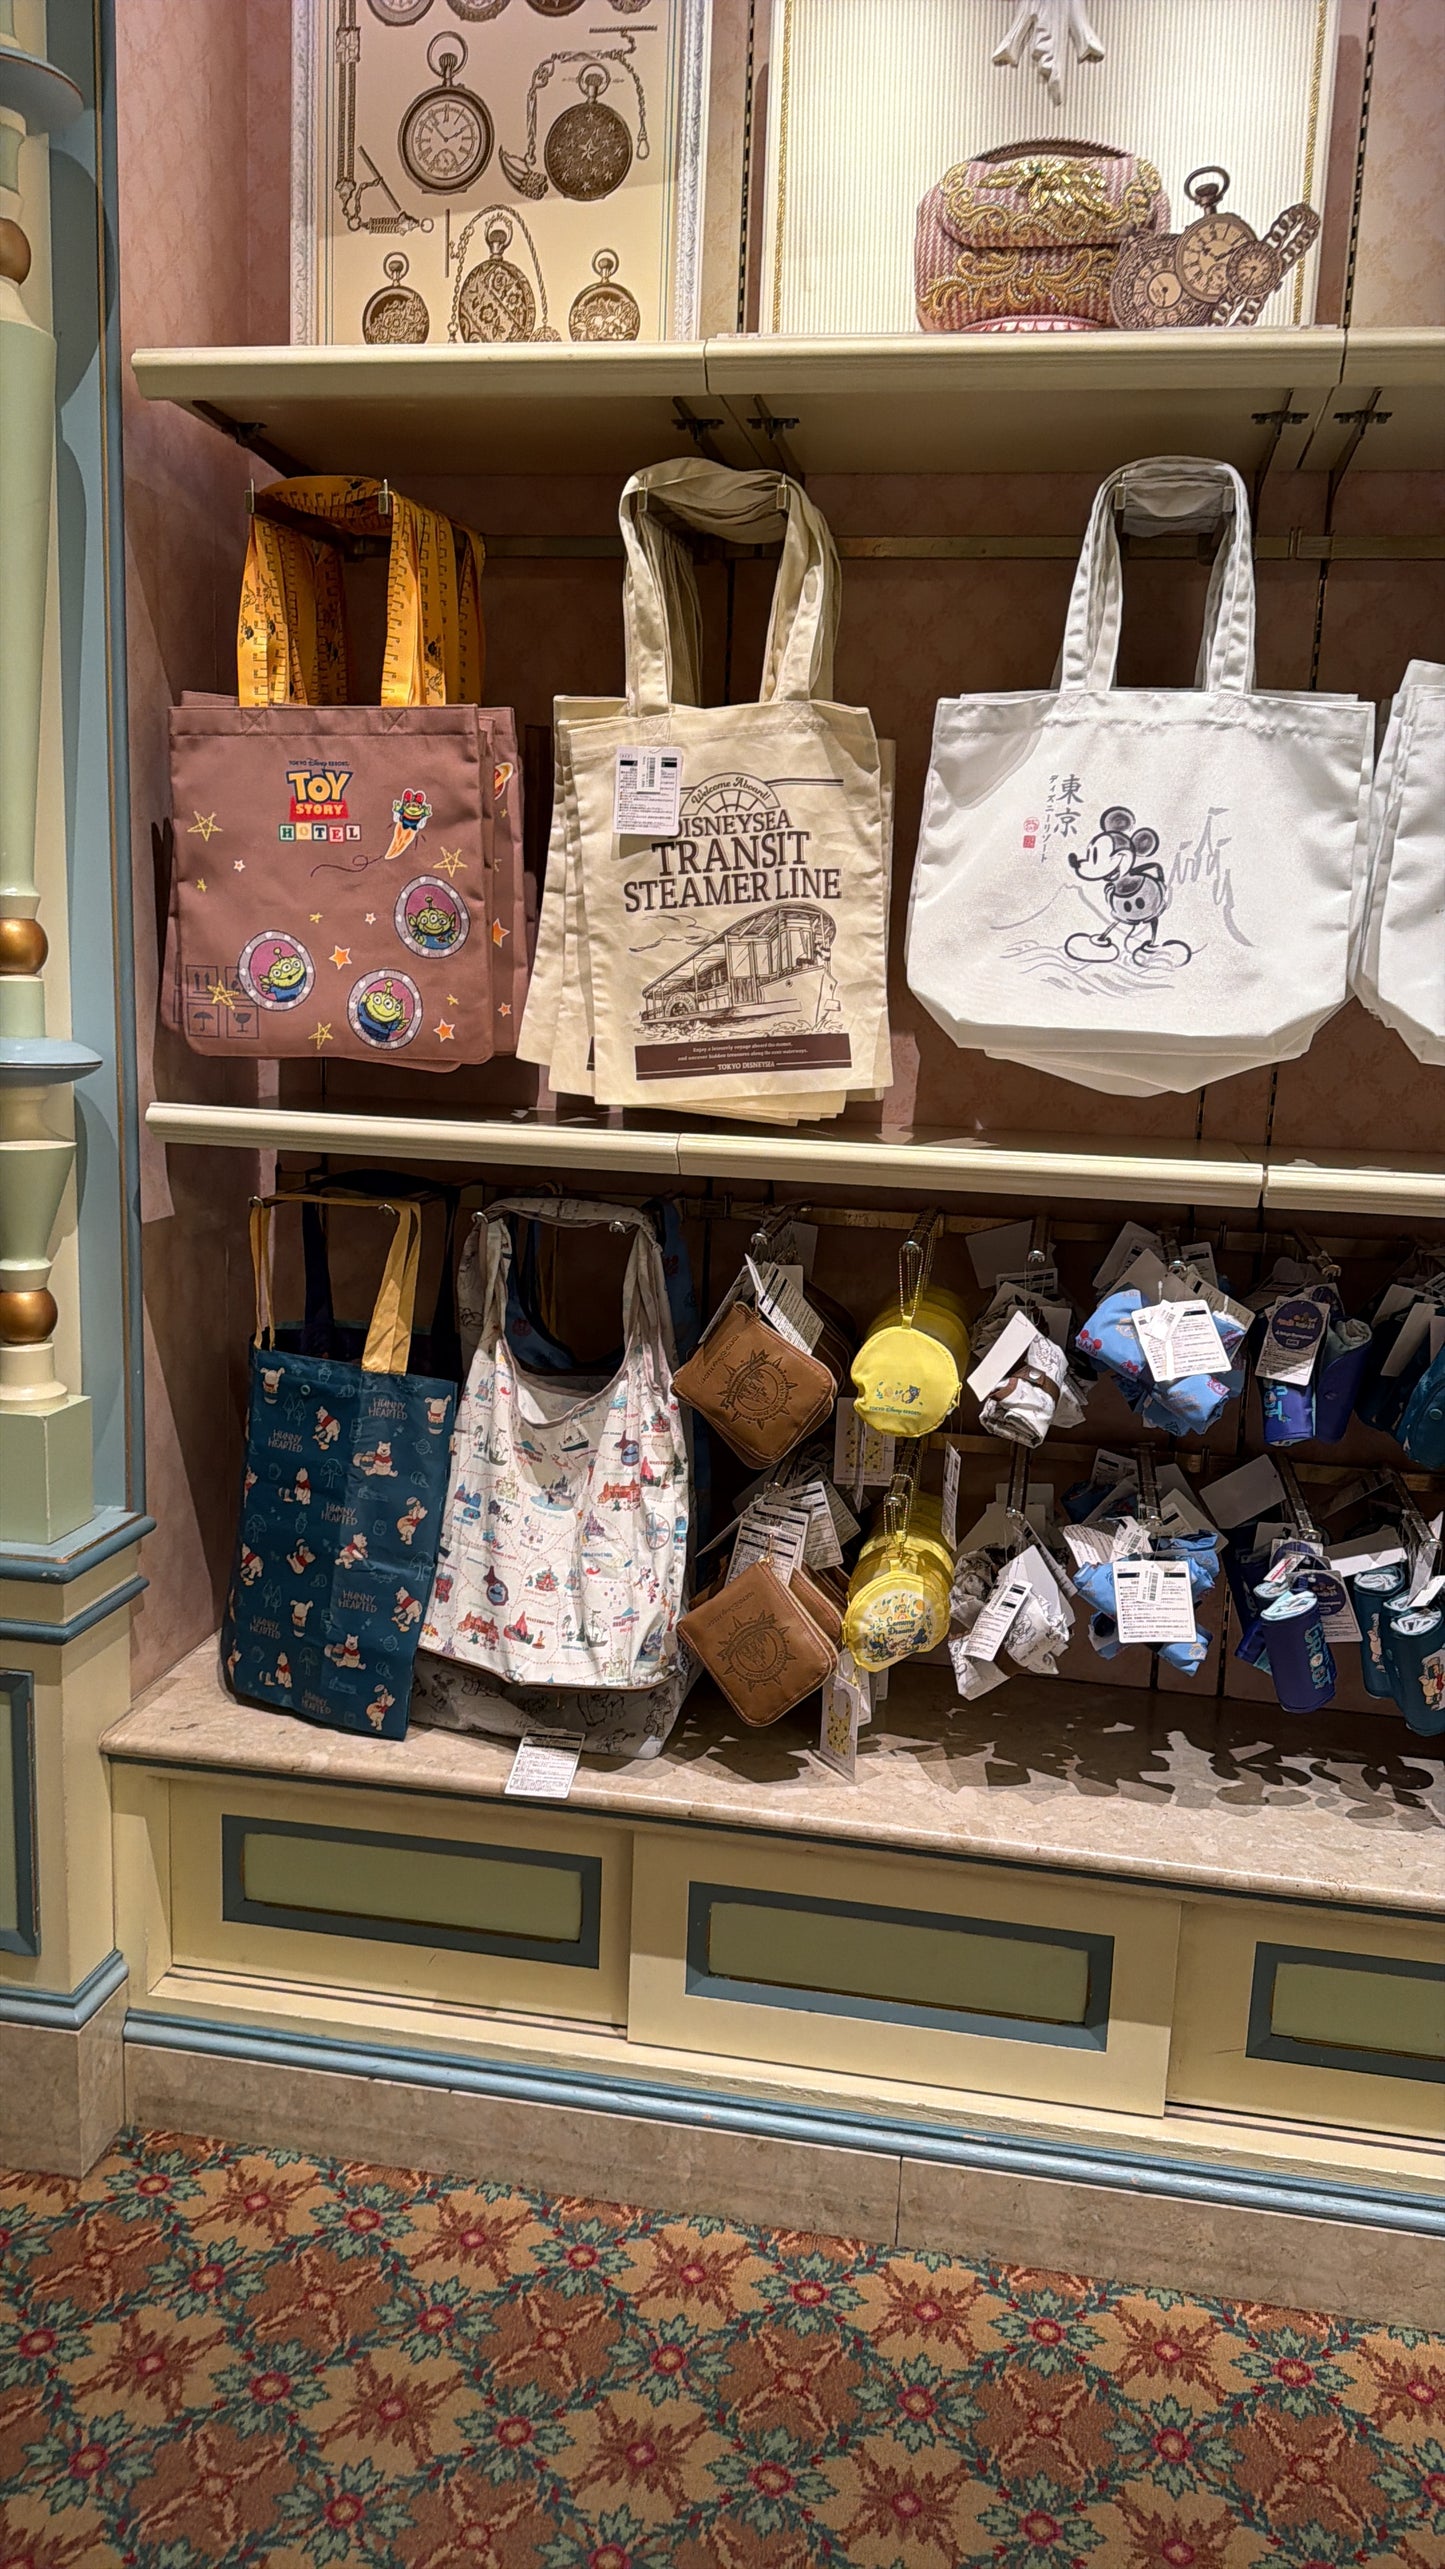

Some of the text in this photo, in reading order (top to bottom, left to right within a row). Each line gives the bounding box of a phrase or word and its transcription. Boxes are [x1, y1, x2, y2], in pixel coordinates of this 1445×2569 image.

[286, 769, 353, 804] TOY
[691, 776, 772, 804] Welcome Aboard!
[295, 803, 344, 816] STORY
[1053, 773, 1085, 838] 東京
[1041, 774, 1059, 863] ディズニーリゾート
[280, 824, 360, 842] HOTEL
[651, 830, 811, 877] TRANSIT
[623, 867, 843, 913] STEAMER LINE
[717, 1060, 775, 1071] TOKYO DISNEYSEA
[373, 1397, 407, 1411] HUNNY
[368, 1406, 408, 1421] HEARTED
[273, 1429, 303, 1443] HUNNY
[267, 1437, 304, 1453] HEARTED
[326, 1502, 357, 1516] HUNNY
[321, 1510, 359, 1526] HEARTED
[343, 1589, 376, 1603] HUNNY
[338, 1598, 378, 1614] HEARTED
